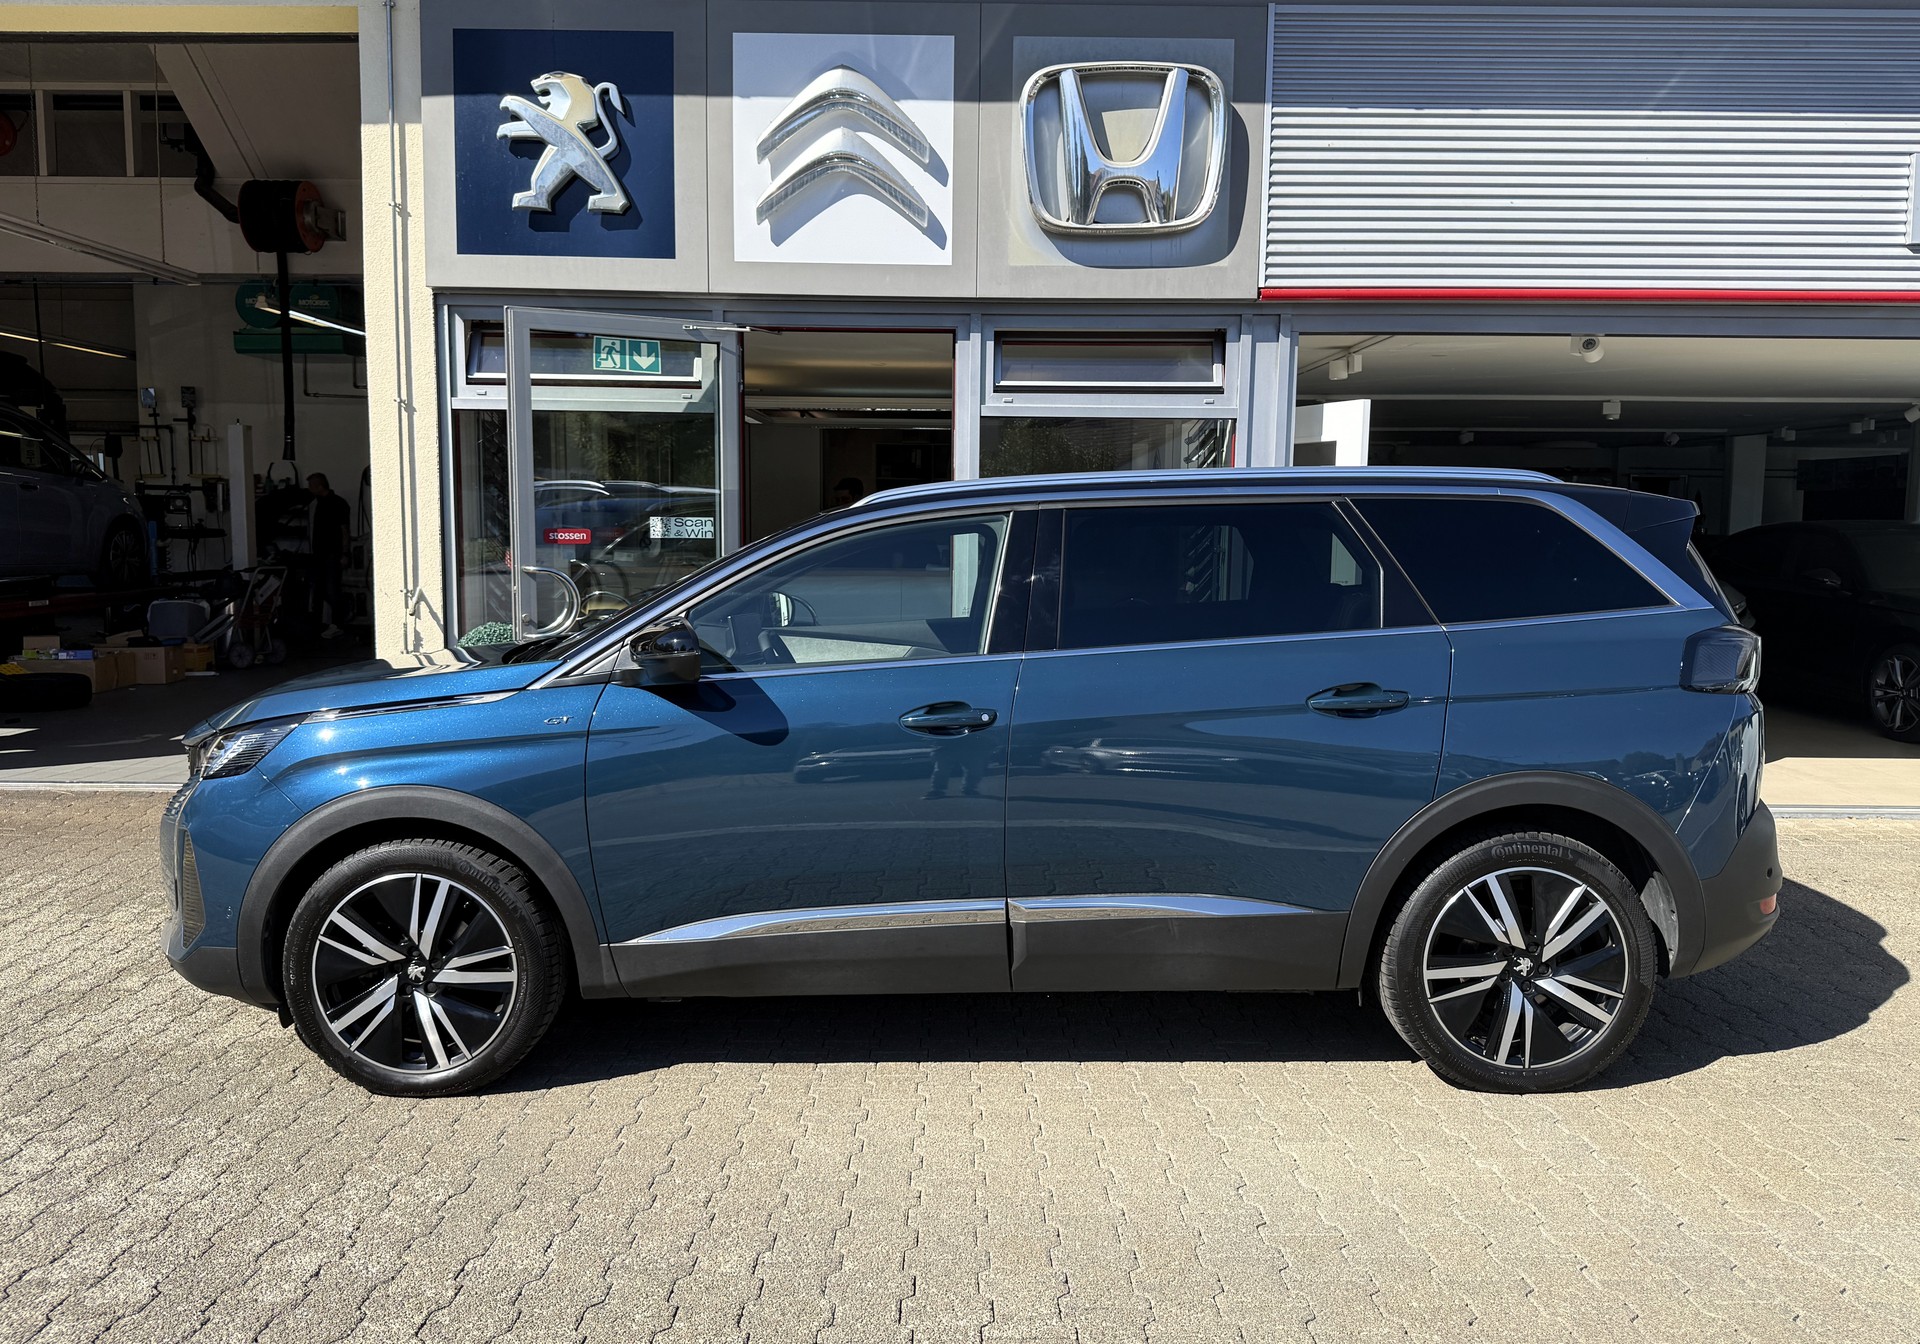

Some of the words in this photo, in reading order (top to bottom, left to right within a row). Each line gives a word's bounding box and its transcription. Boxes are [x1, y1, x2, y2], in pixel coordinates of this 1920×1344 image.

[674, 517, 713, 528] Scan
[549, 532, 587, 540] stossen
[687, 528, 713, 538] Win
[1491, 842, 1563, 857] Continental
